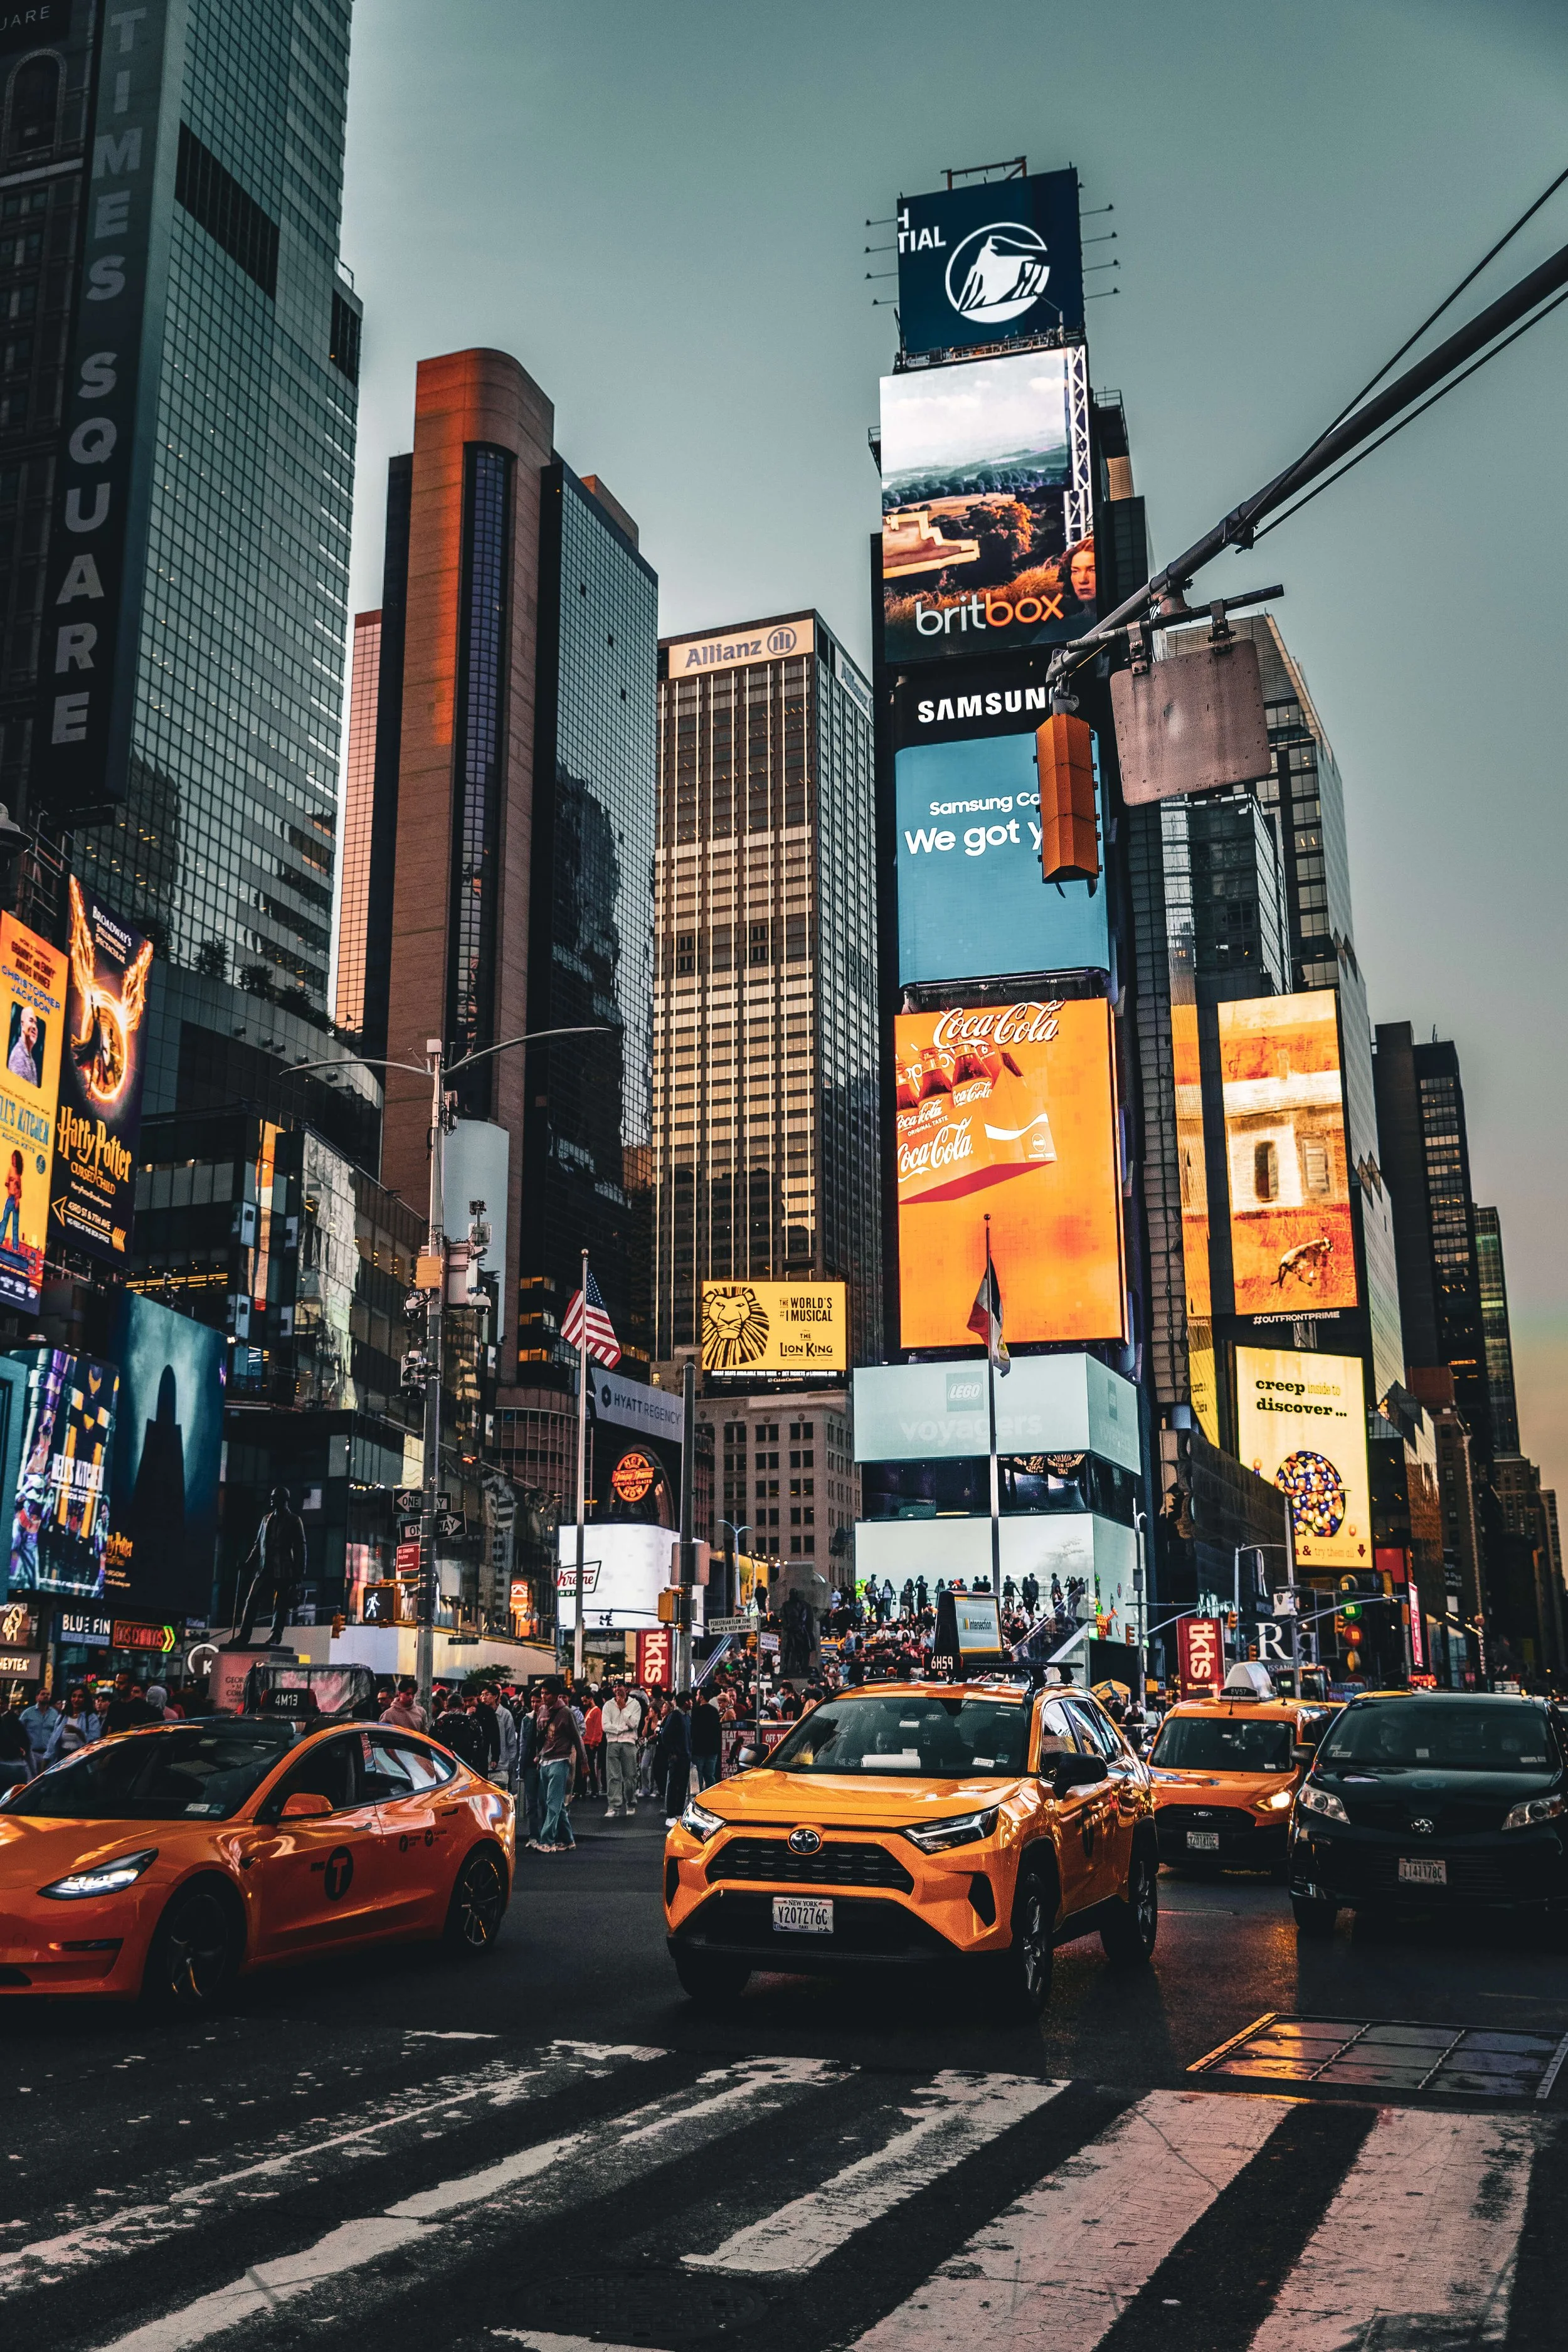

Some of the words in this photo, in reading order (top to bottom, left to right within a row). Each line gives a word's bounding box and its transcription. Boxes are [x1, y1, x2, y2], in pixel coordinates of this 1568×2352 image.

[87, 7, 147, 301] TIMES
[51, 352, 117, 744] SQUARE
[916, 592, 1064, 636] britbox
[686, 639, 761, 668] Allianz
[930, 795, 1012, 815] Samsung
[1017, 792, 1041, 807] Ca
[904, 827, 955, 855] We
[963, 818, 1020, 856] got
[1027, 822, 1043, 850] y
[2, 965, 60, 1010] CHRISTOPHER
[11, 985, 50, 1014] JACKSON
[933, 1000, 1066, 1049] Coca-Cola
[908, 1123, 932, 1136] ORIGINAL
[932, 1115, 949, 1126] TASTE
[57, 1106, 96, 1163] Harry
[95, 1119, 132, 1183] Potter
[71, 1162, 96, 1184] CURSED
[96, 1176, 115, 1194] CHILD
[790, 1297, 832, 1309] WORLD'S
[792, 1310, 833, 1322] MUSICAL
[1253, 1311, 1340, 1325] #OUTFRONTPRIME
[949, 1382, 982, 1400] LEGO
[1256, 1380, 1305, 1396] creep
[614, 1393, 642, 1413] HYATT
[644, 1404, 681, 1425] REGENCY
[900, 1415, 1042, 1447] voyagers
[624, 1456, 642, 1468] HOT
[403, 1496, 419, 1507] ONE
[623, 1486, 643, 1497] NOW
[410, 1525, 421, 1535] ON
[1302, 1545, 1311, 1555] &
[63, 1614, 90, 1634] BLUE
[93, 1618, 110, 1634] FIN
[969, 1618, 992, 1629] Intersection
[1189, 1622, 1216, 1678] tkts
[1255, 1623, 1294, 1660] R
[645, 1631, 668, 1683] tkts
[931, 1656, 953, 1670] 6H59
[275, 1695, 298, 1706] 4M13
[778, 1906, 828, 1925] Y207276C
